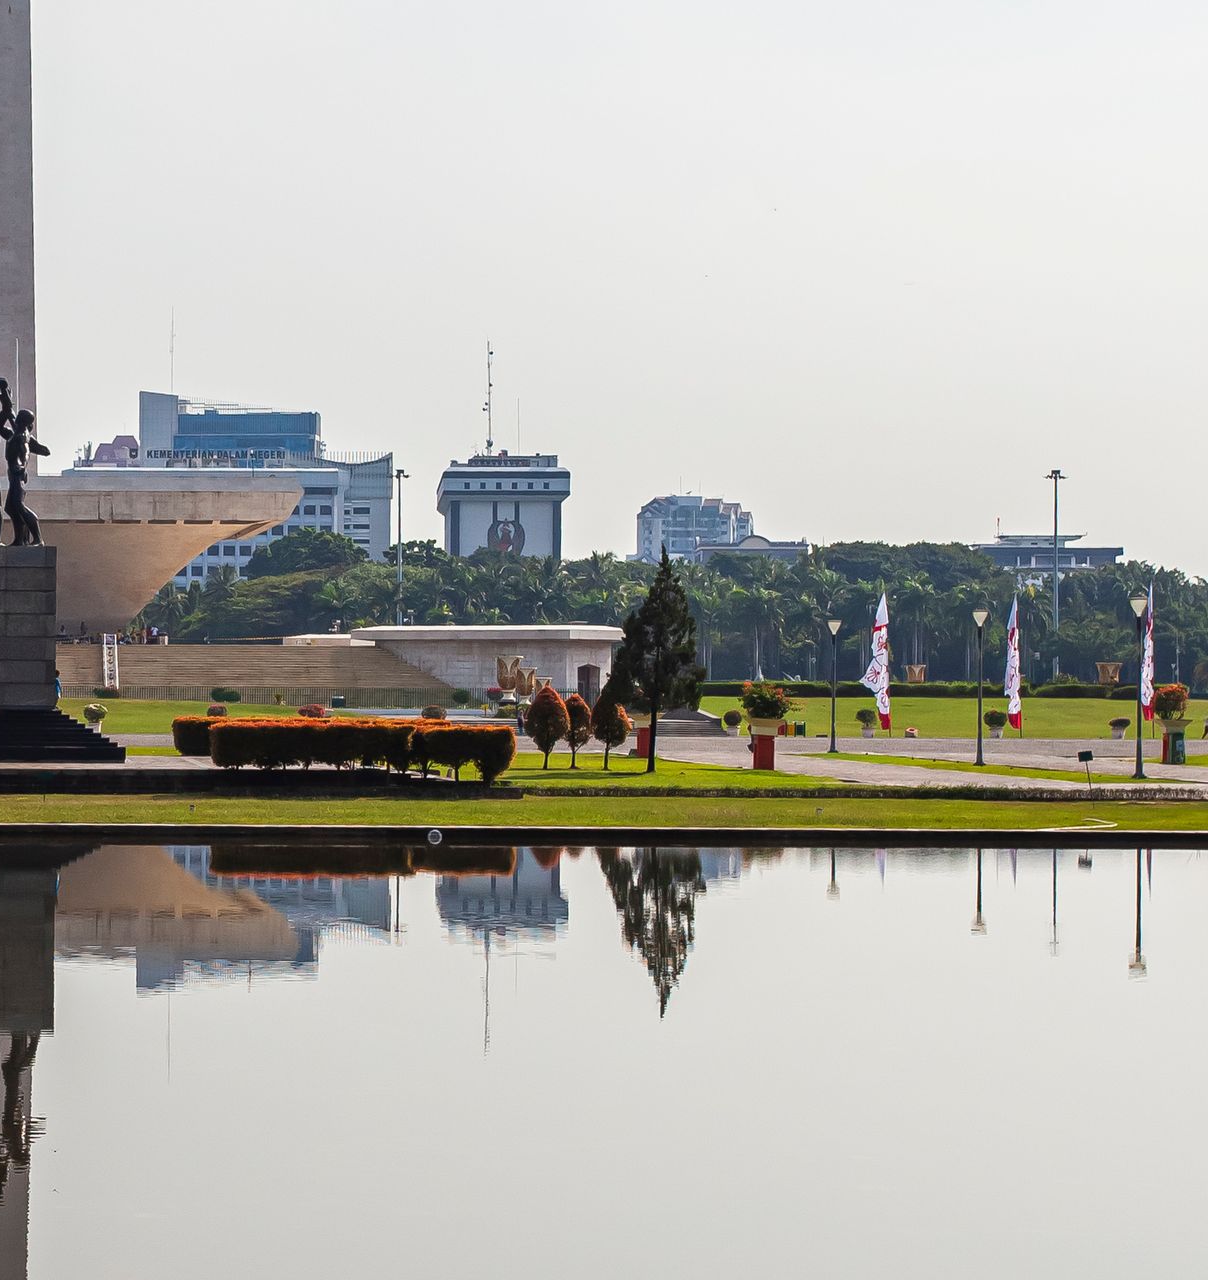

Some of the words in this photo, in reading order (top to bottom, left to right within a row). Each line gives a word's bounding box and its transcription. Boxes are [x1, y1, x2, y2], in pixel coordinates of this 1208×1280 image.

[146, 449, 214, 459] KEMENTERIAN
[217, 450, 248, 459] DALAM
[251, 450, 286, 460] NEGERI
